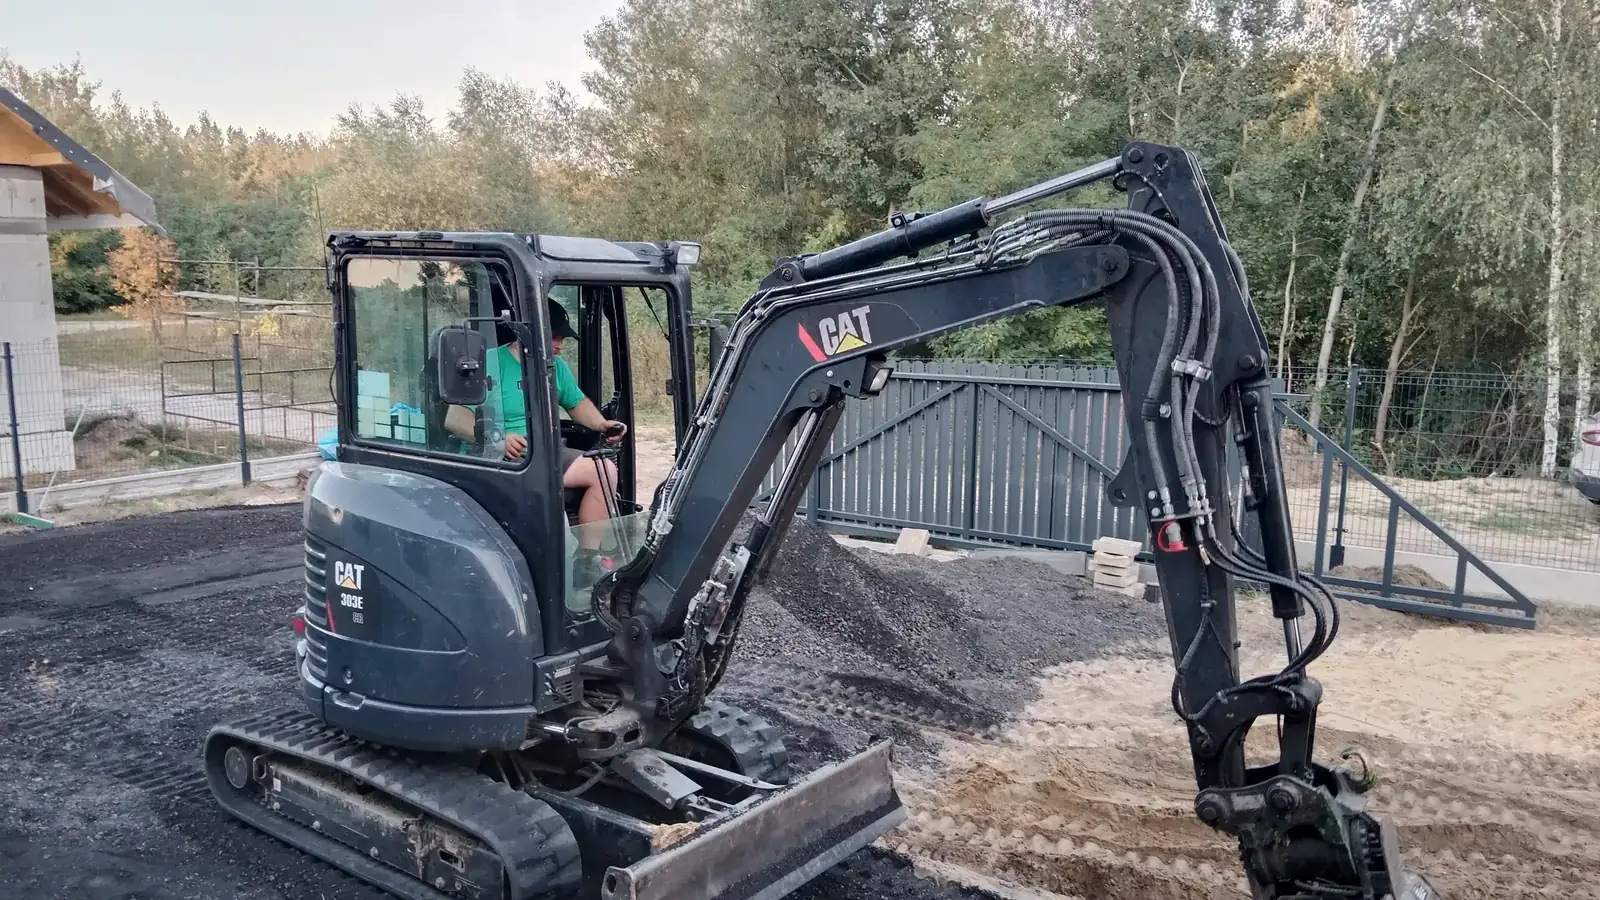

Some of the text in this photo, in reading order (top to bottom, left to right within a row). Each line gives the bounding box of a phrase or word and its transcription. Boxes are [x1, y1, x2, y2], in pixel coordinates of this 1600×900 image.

[819, 305, 872, 355] CAT
[335, 561, 364, 590] CAT
[341, 593, 363, 609] 303E
